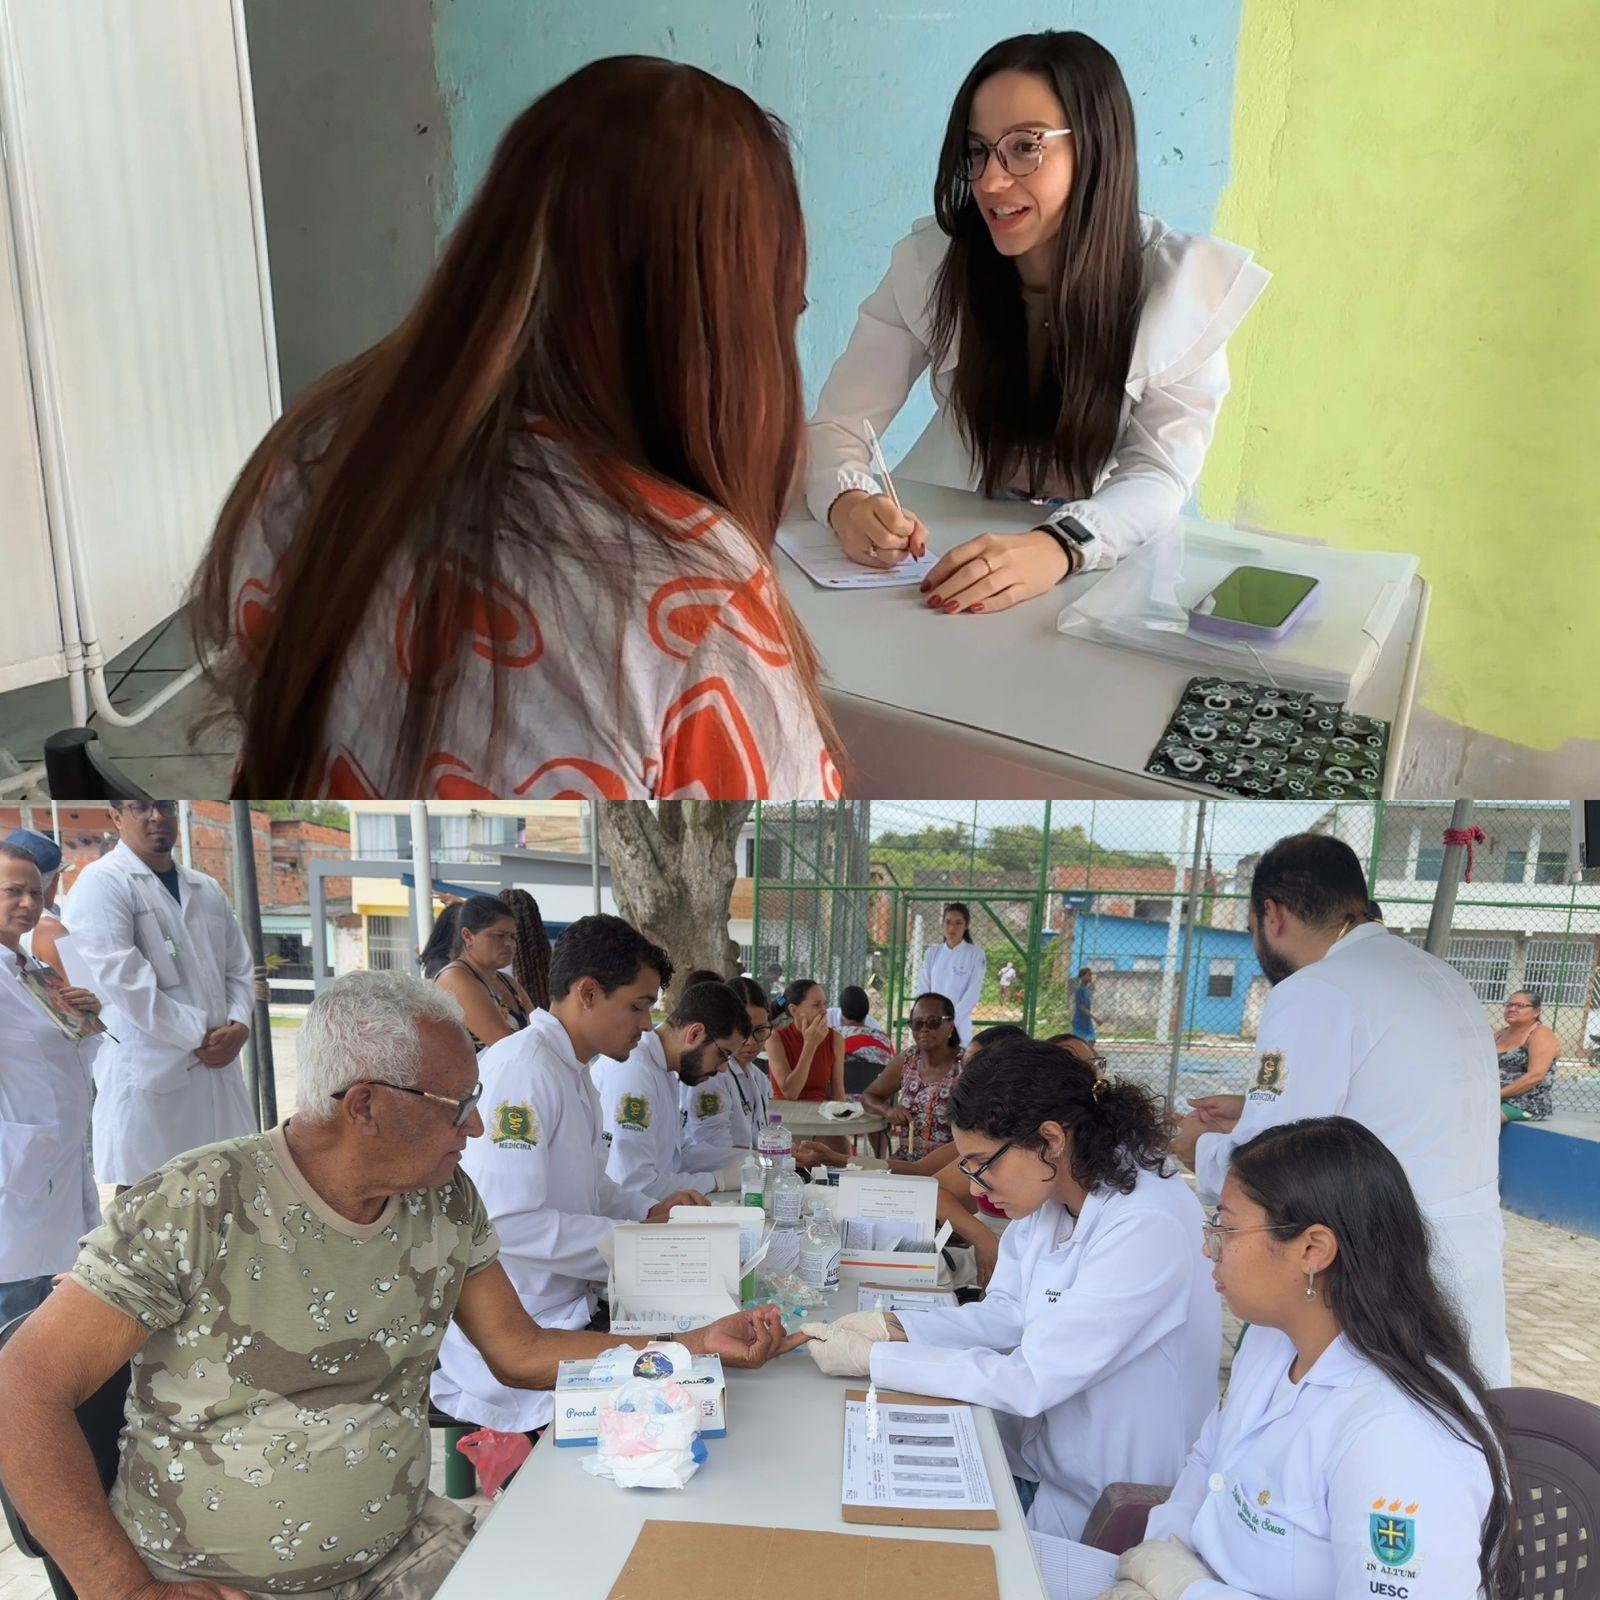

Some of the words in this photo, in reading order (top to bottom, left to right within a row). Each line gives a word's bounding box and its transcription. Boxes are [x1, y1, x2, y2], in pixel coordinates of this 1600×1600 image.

[1249, 1092, 1277, 1102] MEDICINA
[498, 1141, 532, 1151] MEDICINA
[566, 1406, 597, 1419] Proced
[1366, 1562, 1377, 1571] IN
[1380, 1565, 1416, 1578] ALTUM
[1369, 1580, 1409, 1599] UESC
